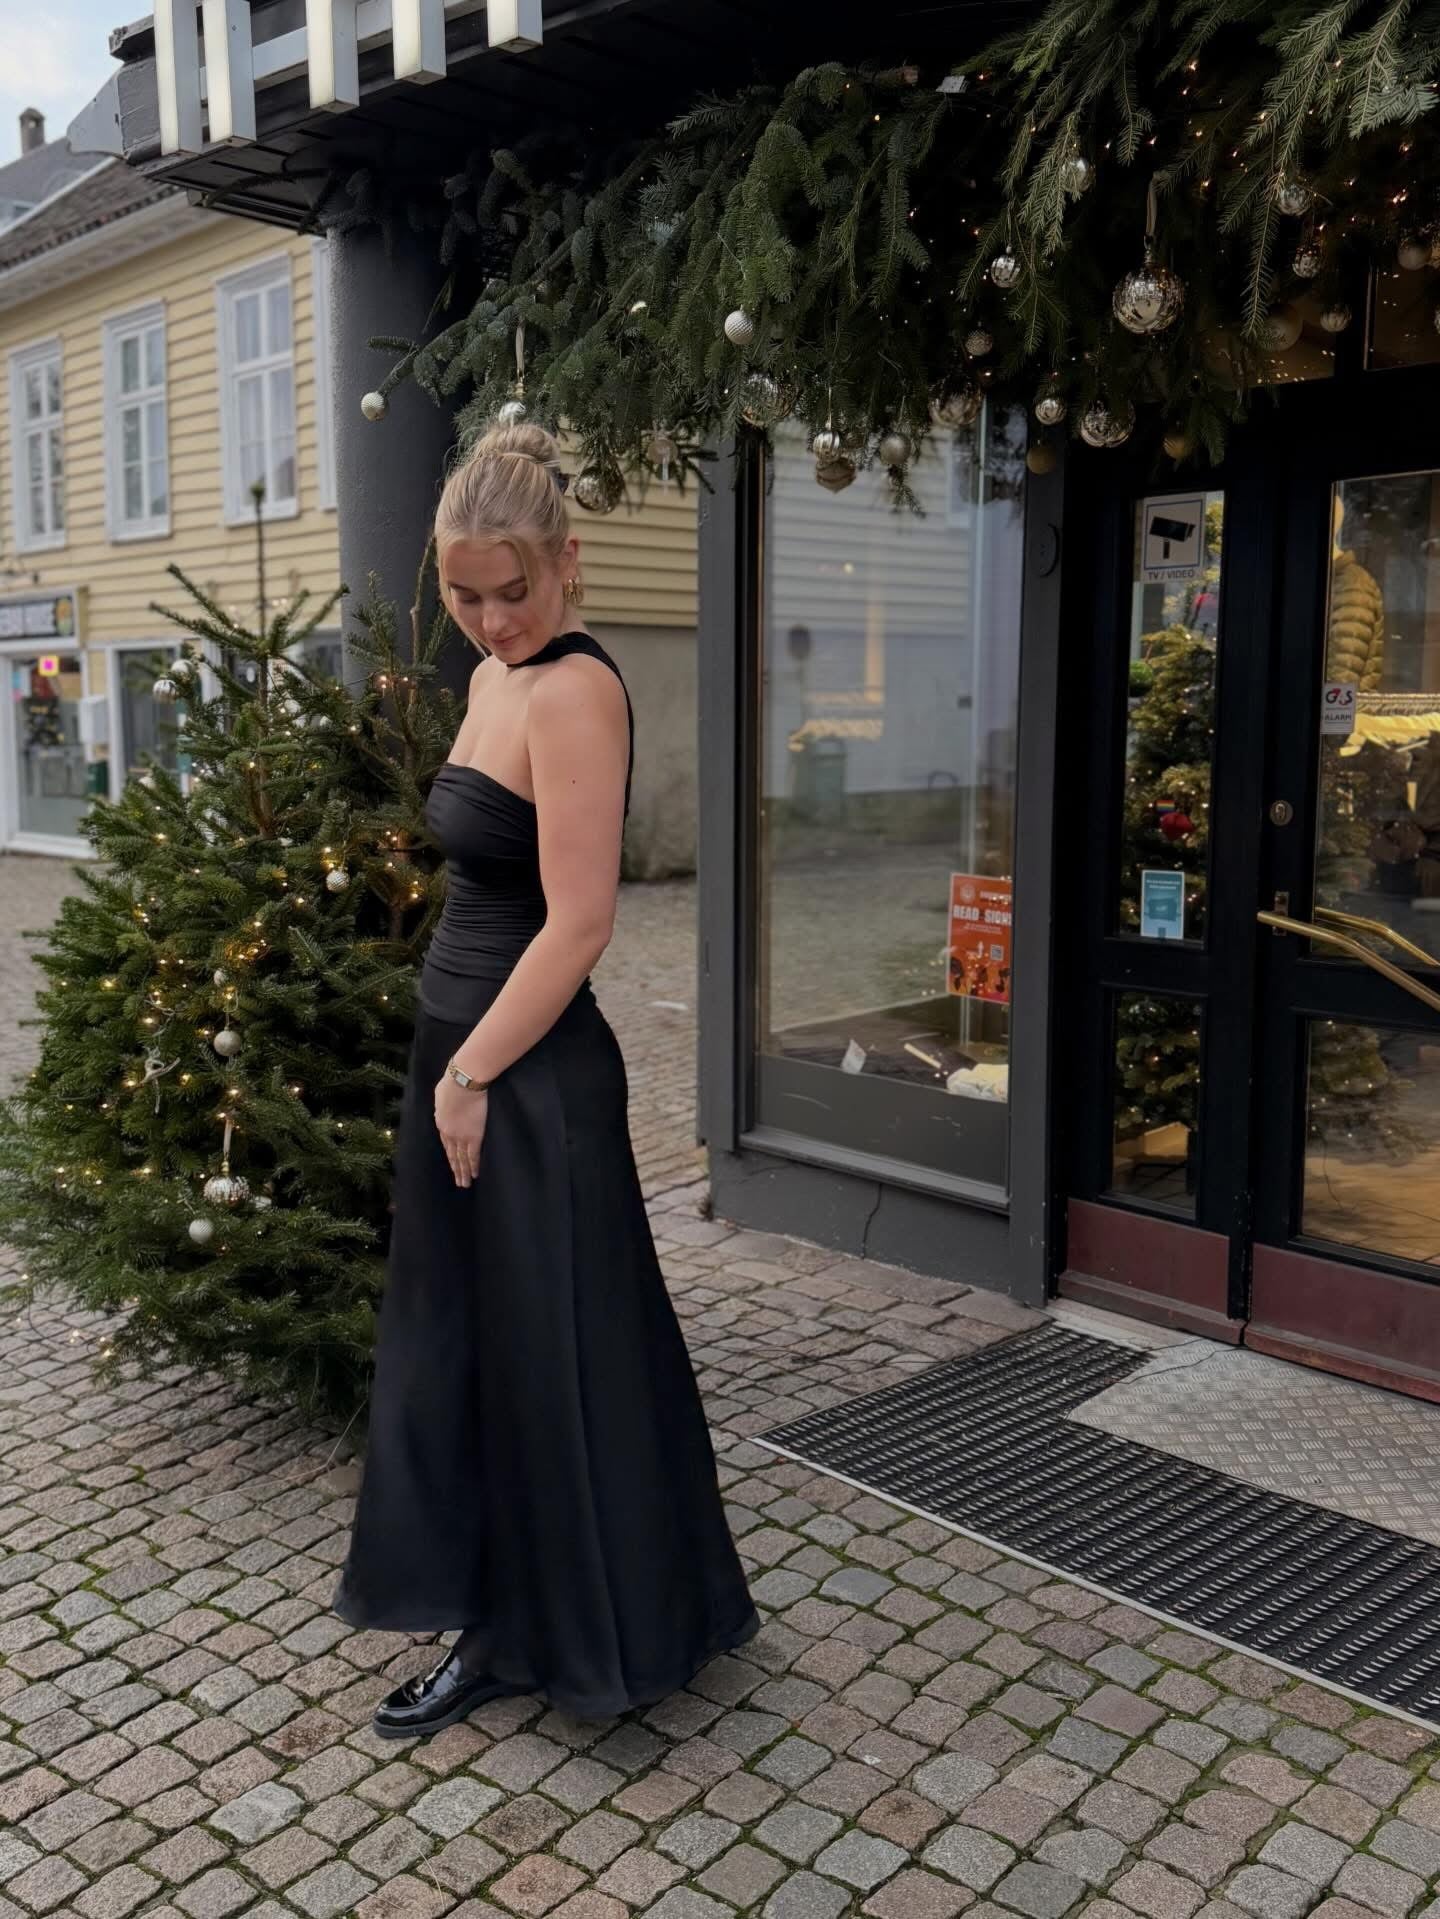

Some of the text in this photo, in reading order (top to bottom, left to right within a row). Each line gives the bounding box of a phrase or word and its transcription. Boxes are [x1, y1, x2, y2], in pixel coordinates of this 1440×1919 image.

[1148, 571, 1159, 580] TV
[1168, 569, 1194, 579] VIDEO
[1325, 713, 1352, 721] ALARM
